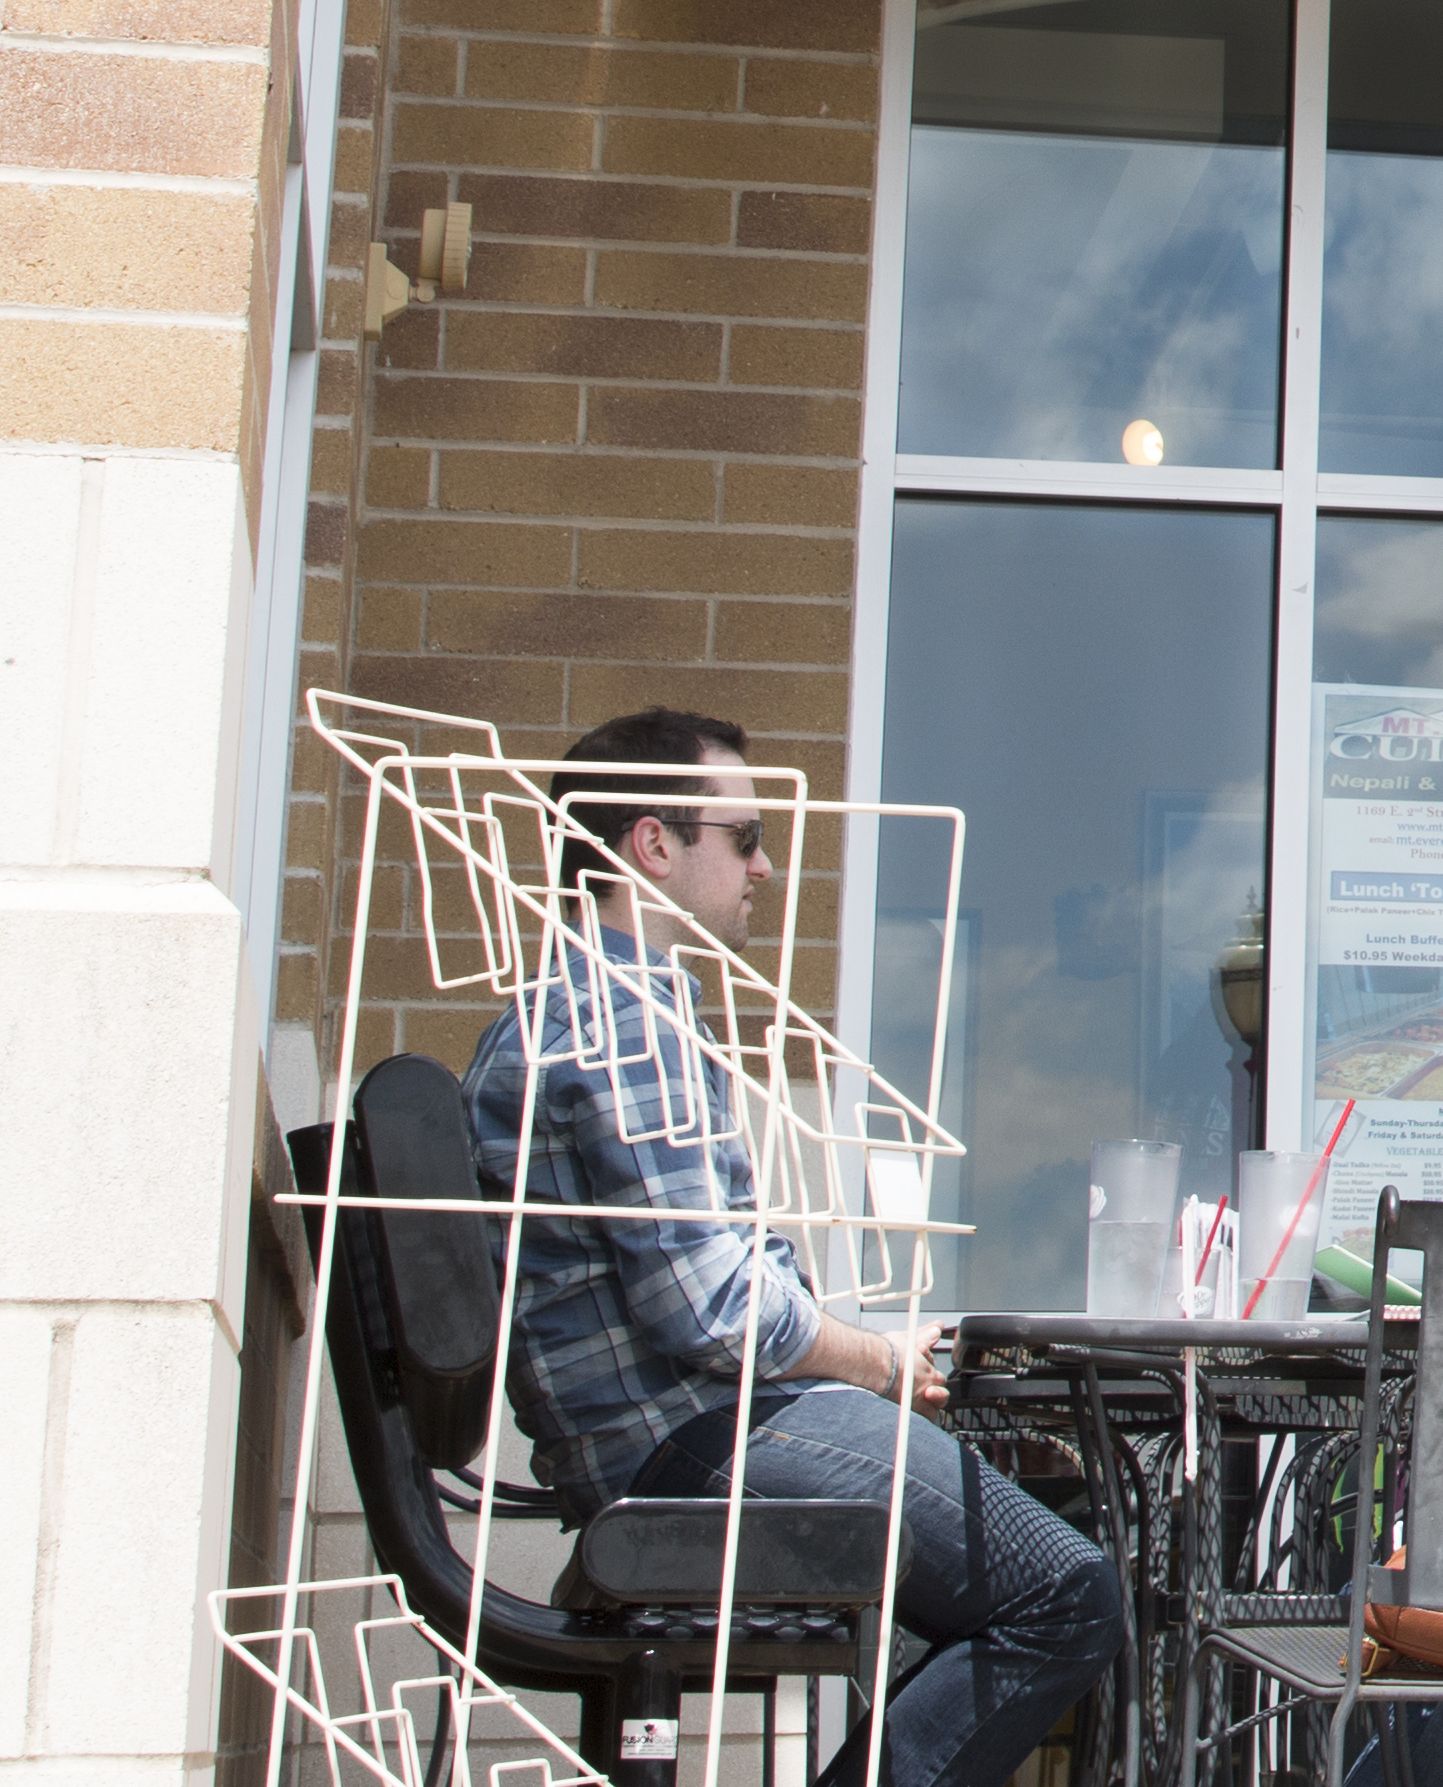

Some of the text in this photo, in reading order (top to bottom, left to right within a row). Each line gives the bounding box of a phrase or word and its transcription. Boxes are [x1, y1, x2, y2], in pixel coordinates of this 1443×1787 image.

[1382, 716, 1440, 736] MT.
[1330, 773, 1410, 792] Nepali
[1418, 776, 1436, 790] &
[1357, 805, 1386, 816] 1169
[1340, 880, 1404, 898] Lunch
[1366, 933, 1406, 945] Lunch
[1343, 950, 1388, 961] $10.95
[1368, 1131, 1397, 1140] Friday
[1400, 1131, 1407, 1139] &
